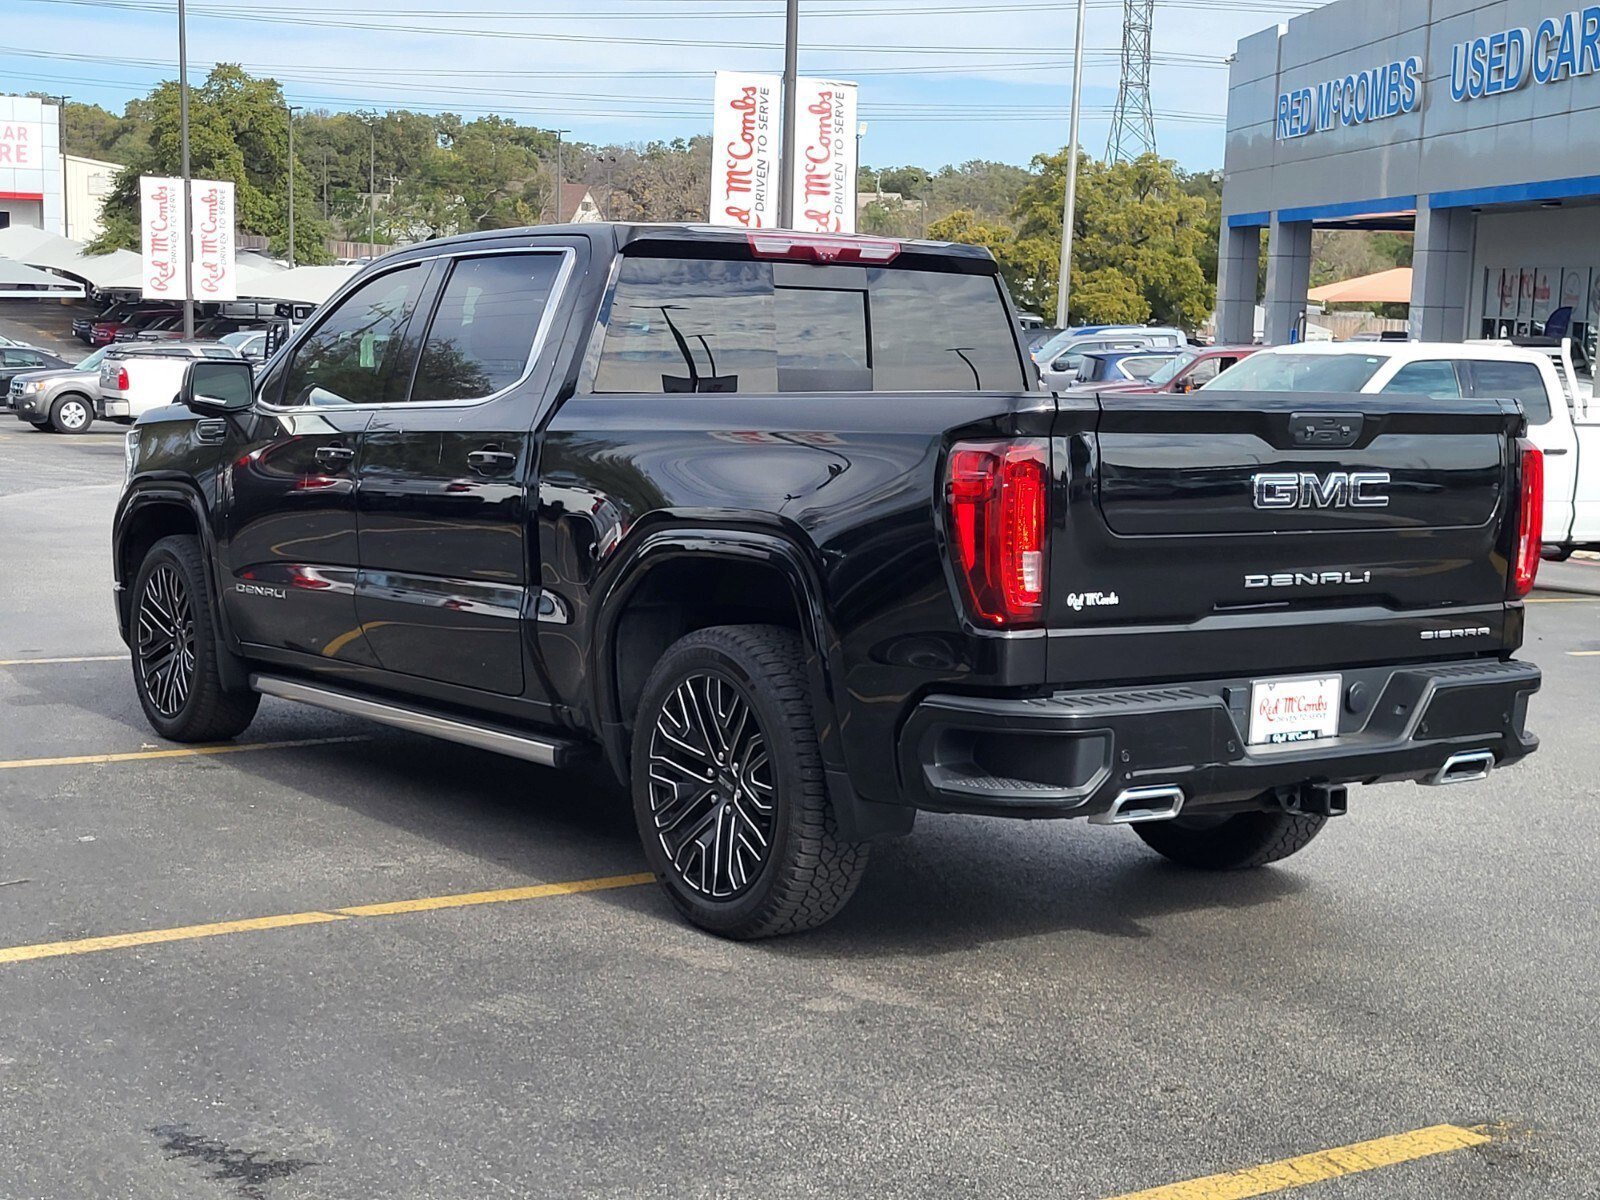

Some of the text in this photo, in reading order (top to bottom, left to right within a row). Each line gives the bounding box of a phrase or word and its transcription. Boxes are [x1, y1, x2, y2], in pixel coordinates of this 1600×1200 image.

[1450, 5, 1600, 102] USED CAR
[1276, 87, 1316, 140] RED
[0, 126, 28, 141] AR
[726, 86, 757, 200] McCombs
[755, 87, 770, 212] DRIVEN TO SERVE
[805, 91, 833, 203] McCombs
[834, 91, 845, 215] DRIVEN TO SERVE
[170, 213, 177, 228] TO
[219, 214, 226, 229] TO
[149, 186, 176, 292] Red McCombs
[170, 231, 178, 264] DRIVEN
[201, 188, 226, 292] Red McCombs
[219, 232, 227, 265] DRIVEN
[1253, 472, 1390, 509] GMC
[235, 583, 287, 599] DENALI
[1245, 571, 1371, 588] DENALI
[1420, 627, 1490, 640] SIERRA
[1259, 695, 1328, 721] Red McCombs
